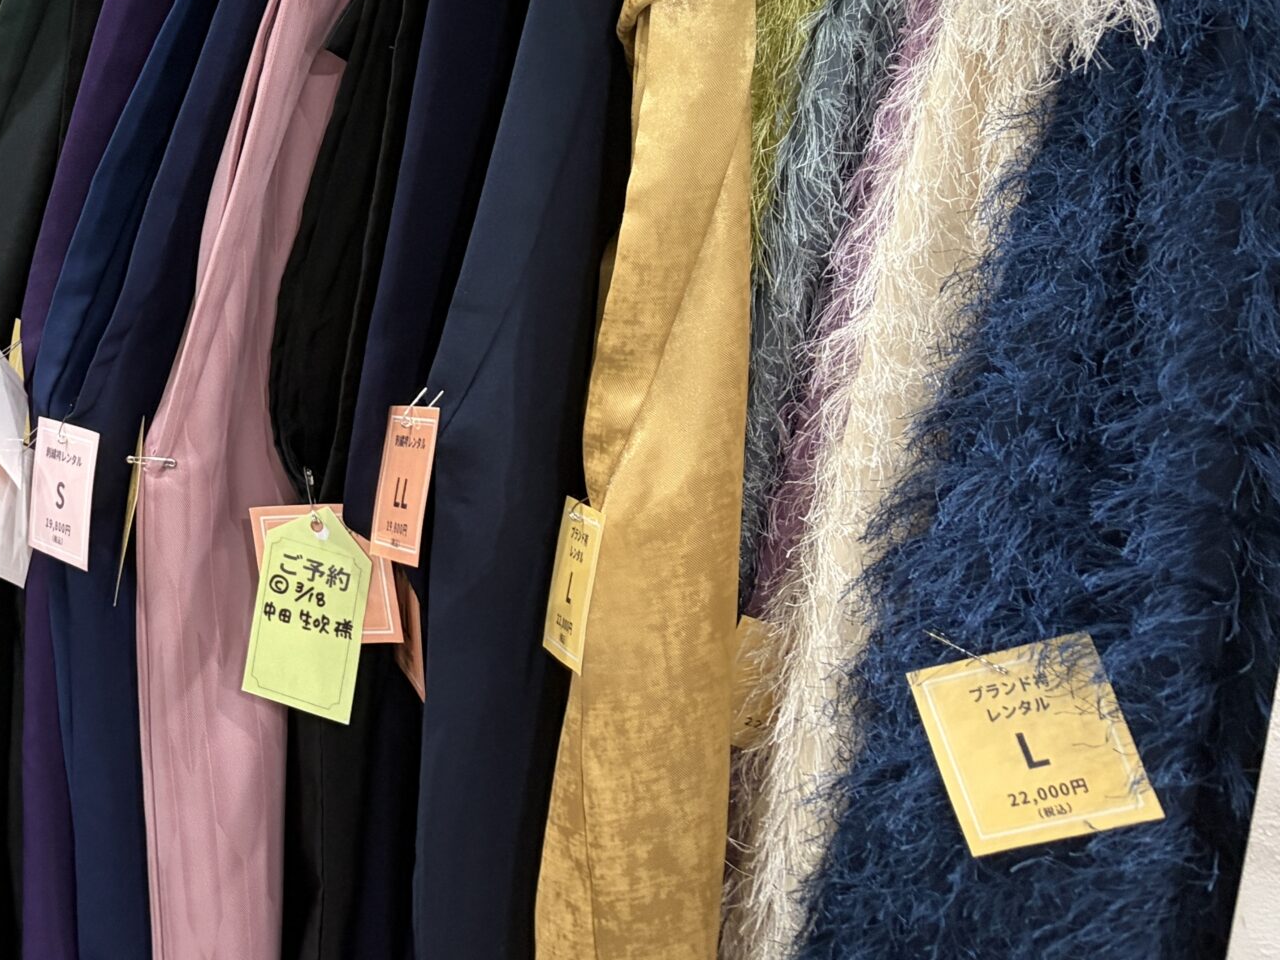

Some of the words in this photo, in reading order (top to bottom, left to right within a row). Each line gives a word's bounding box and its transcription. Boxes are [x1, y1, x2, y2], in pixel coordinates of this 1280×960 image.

[55, 481, 65, 509] S
[393, 477, 408, 509] LL
[280, 553, 351, 592] ご予約
[565, 571, 574, 605] L
[294, 581, 326, 607] 3/18
[987, 697, 1050, 722] レンタル
[1015, 732, 1051, 769] L
[1007, 777, 1090, 808] 22,000円
